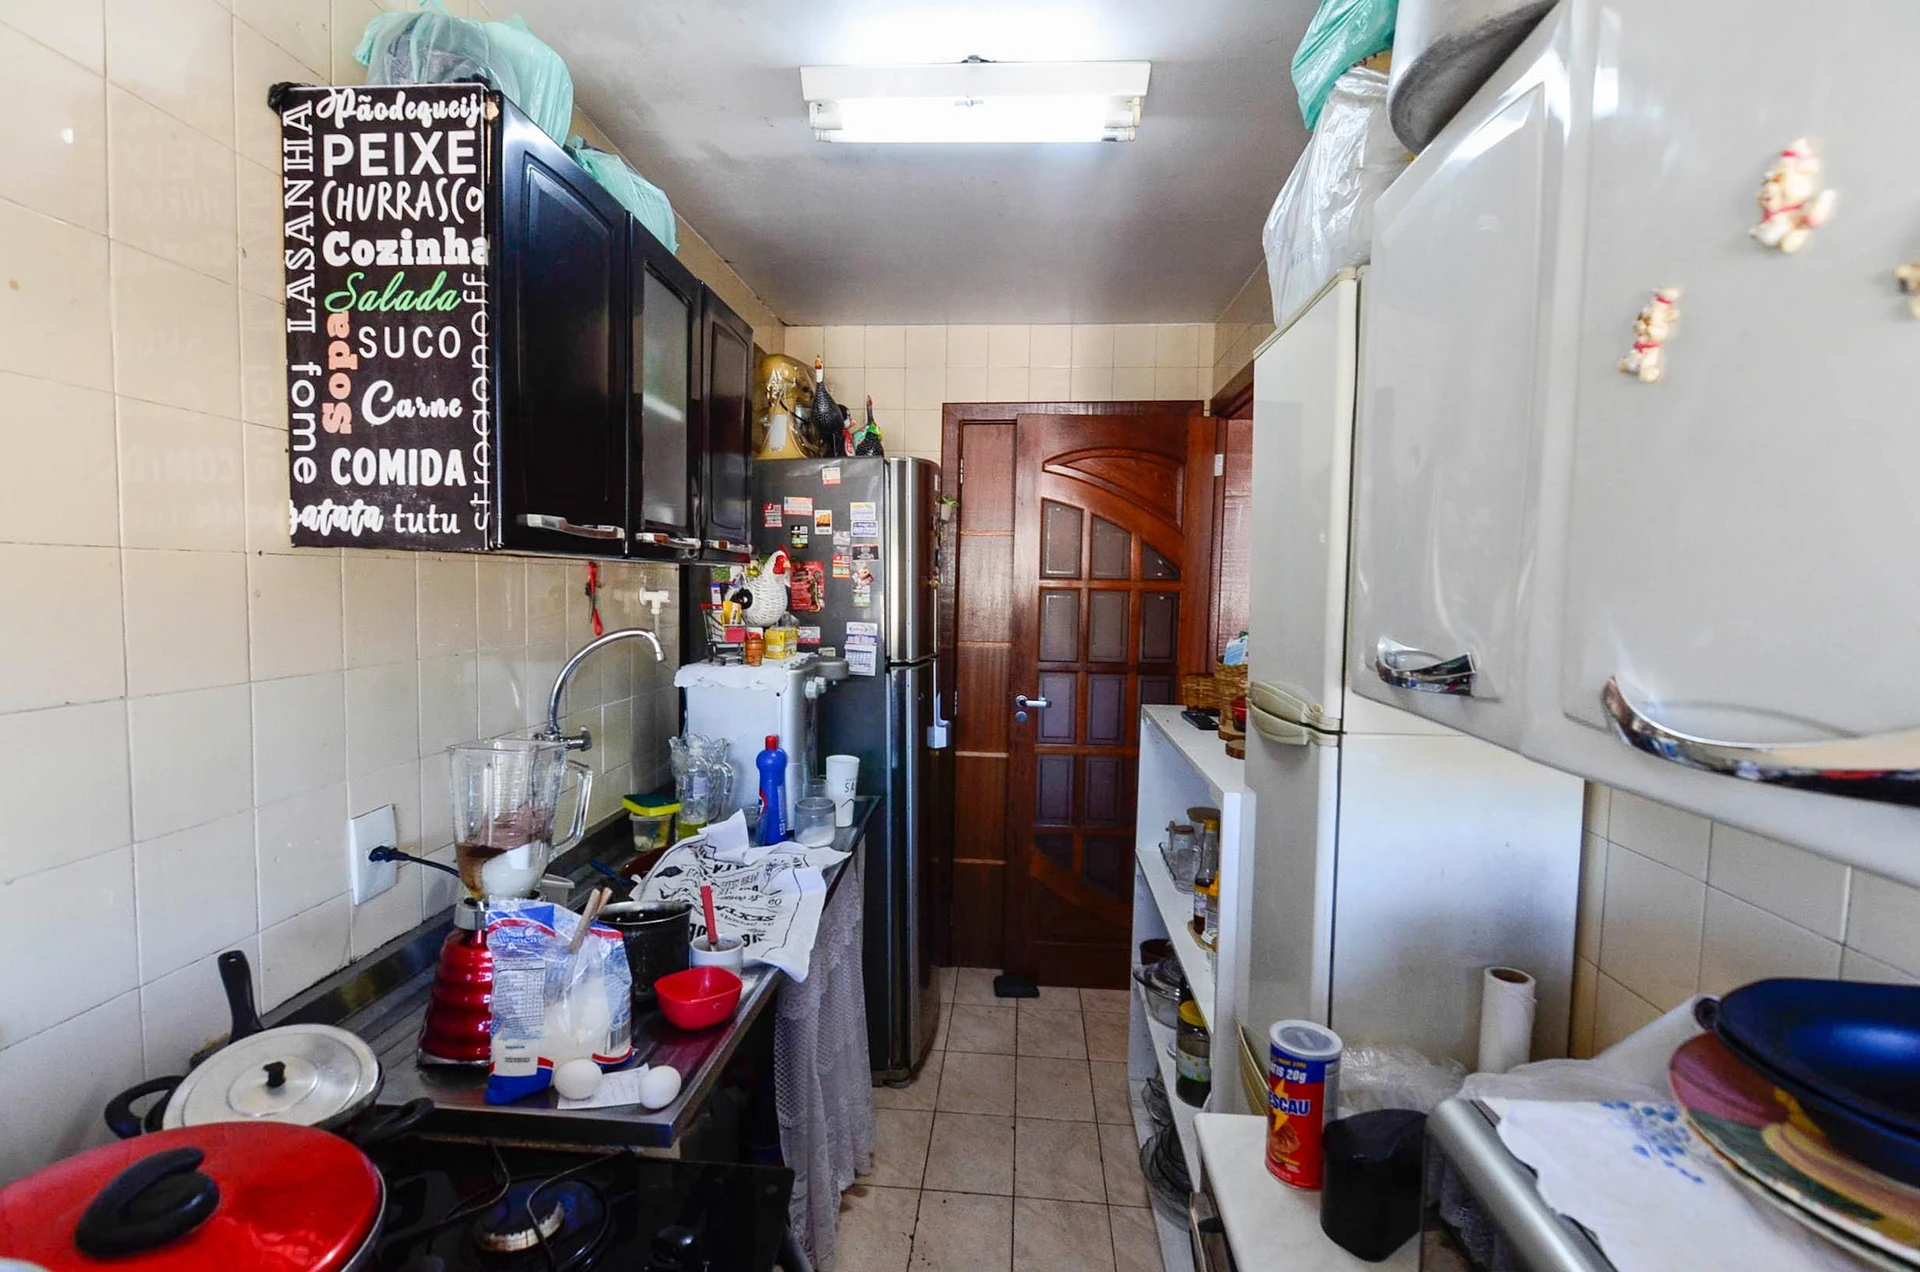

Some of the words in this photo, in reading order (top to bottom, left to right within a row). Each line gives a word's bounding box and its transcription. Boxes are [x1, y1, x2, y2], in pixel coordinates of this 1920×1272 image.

[323, 130, 477, 177] PEIXE
[283, 100, 316, 333] LASANHA
[321, 177, 485, 226] CHURRASCO
[322, 227, 490, 266] Cozinha
[324, 270, 462, 312] Salada
[358, 326, 462, 358] SUCO
[322, 310, 358, 434] Sopa
[291, 361, 322, 484] fome
[361, 380, 463, 425] Carne
[331, 447, 467, 486] COMIDA
[392, 504, 461, 533] tutu
[1286, 1068, 1307, 1084] 20g
[1268, 1091, 1310, 1116] ESCAU
